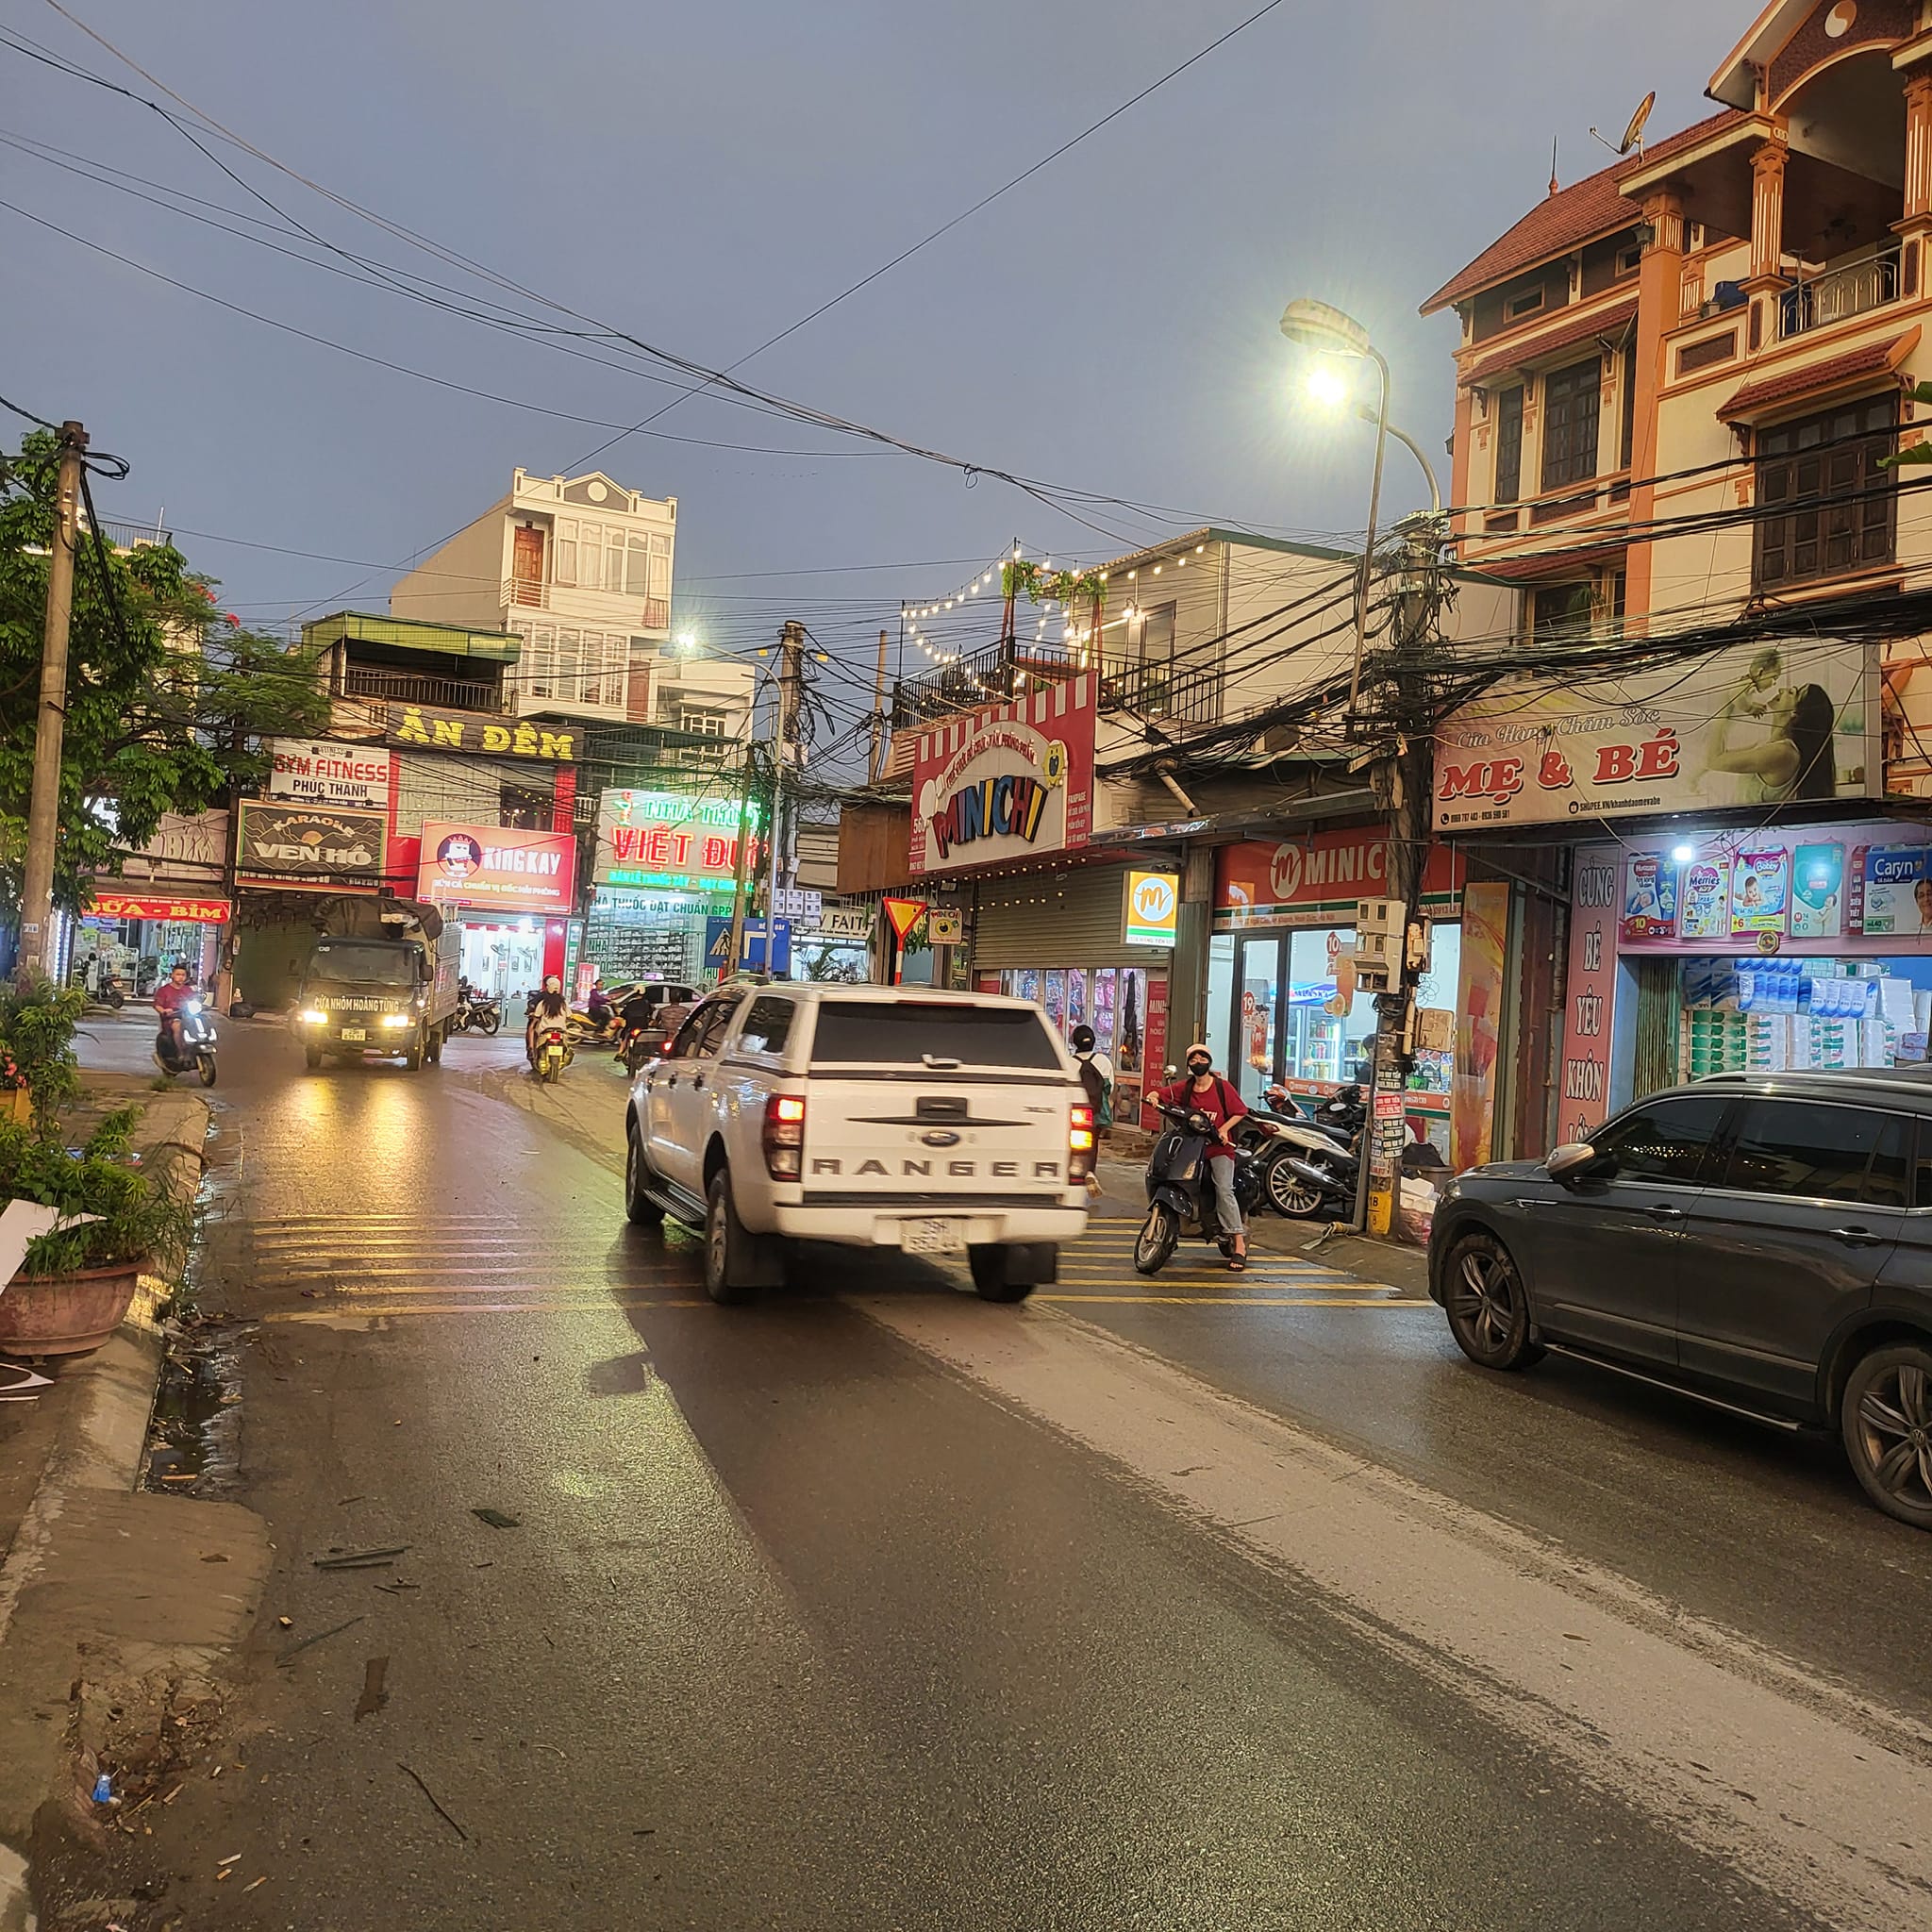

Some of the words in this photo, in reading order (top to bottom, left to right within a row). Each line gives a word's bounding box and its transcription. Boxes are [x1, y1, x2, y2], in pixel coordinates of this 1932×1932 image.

[396, 707, 464, 746] ĂN
[482, 722, 574, 760] ĐÊM
[315, 758, 388, 783] FITNESS
[1438, 758, 1524, 806] MẸ
[1537, 752, 1574, 790] &
[1591, 727, 1680, 785] BÉ
[293, 778, 325, 794] PHÚC
[328, 782, 368, 798] THANH
[253, 841, 320, 862] VEN
[612, 823, 695, 872] VIỆT
[1305, 843, 1388, 885] MINIC
[1874, 858, 1913, 879] Caryn
[1578, 858, 1614, 908] CÙNG
[1689, 875, 1720, 887] Merries
[170, 904, 222, 919] BỈM
[673, 899, 708, 915] CHUẨN
[711, 904, 733, 917] GPP
[832, 914, 875, 931] FAITH
[1635, 917, 1646, 928] 10
[1327, 936, 1339, 953] 10
[1583, 922, 1602, 972] BÉ
[330, 995, 353, 1011] NHÔM
[353, 995, 378, 1012] HOÀNG
[1575, 984, 1604, 1037] YÊU
[1565, 1050, 1605, 1102] KHÔN
[810, 1158, 1059, 1178] RANGER
